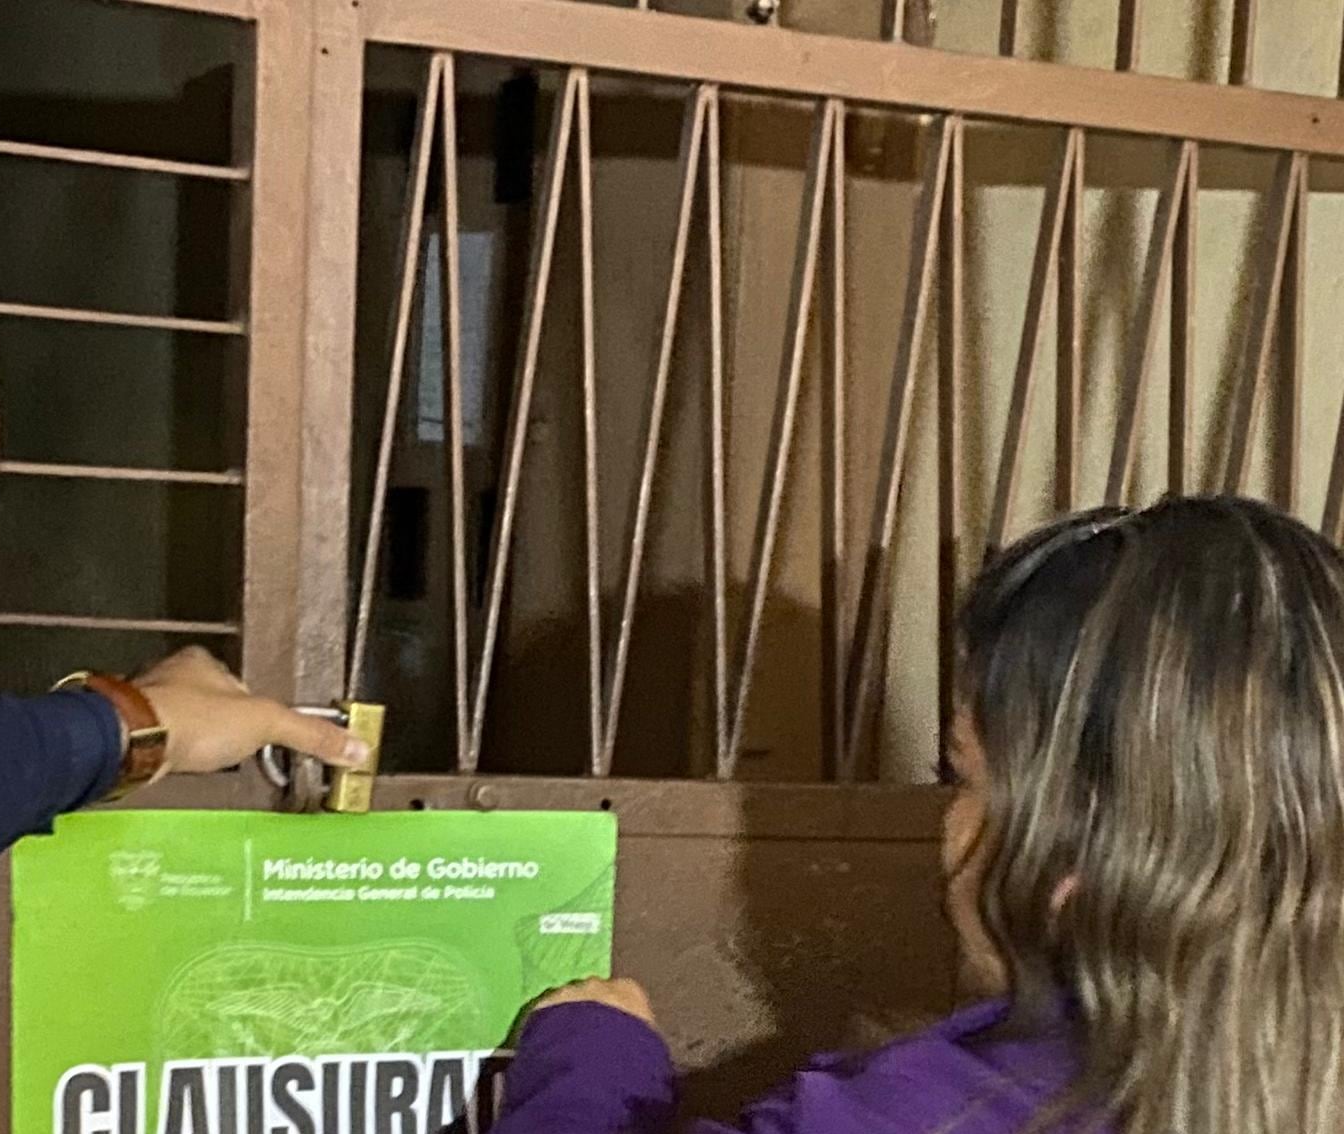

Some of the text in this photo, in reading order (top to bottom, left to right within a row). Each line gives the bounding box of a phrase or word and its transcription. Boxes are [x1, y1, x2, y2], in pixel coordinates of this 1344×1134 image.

[262, 856, 540, 881] Ministerio de Gobierno
